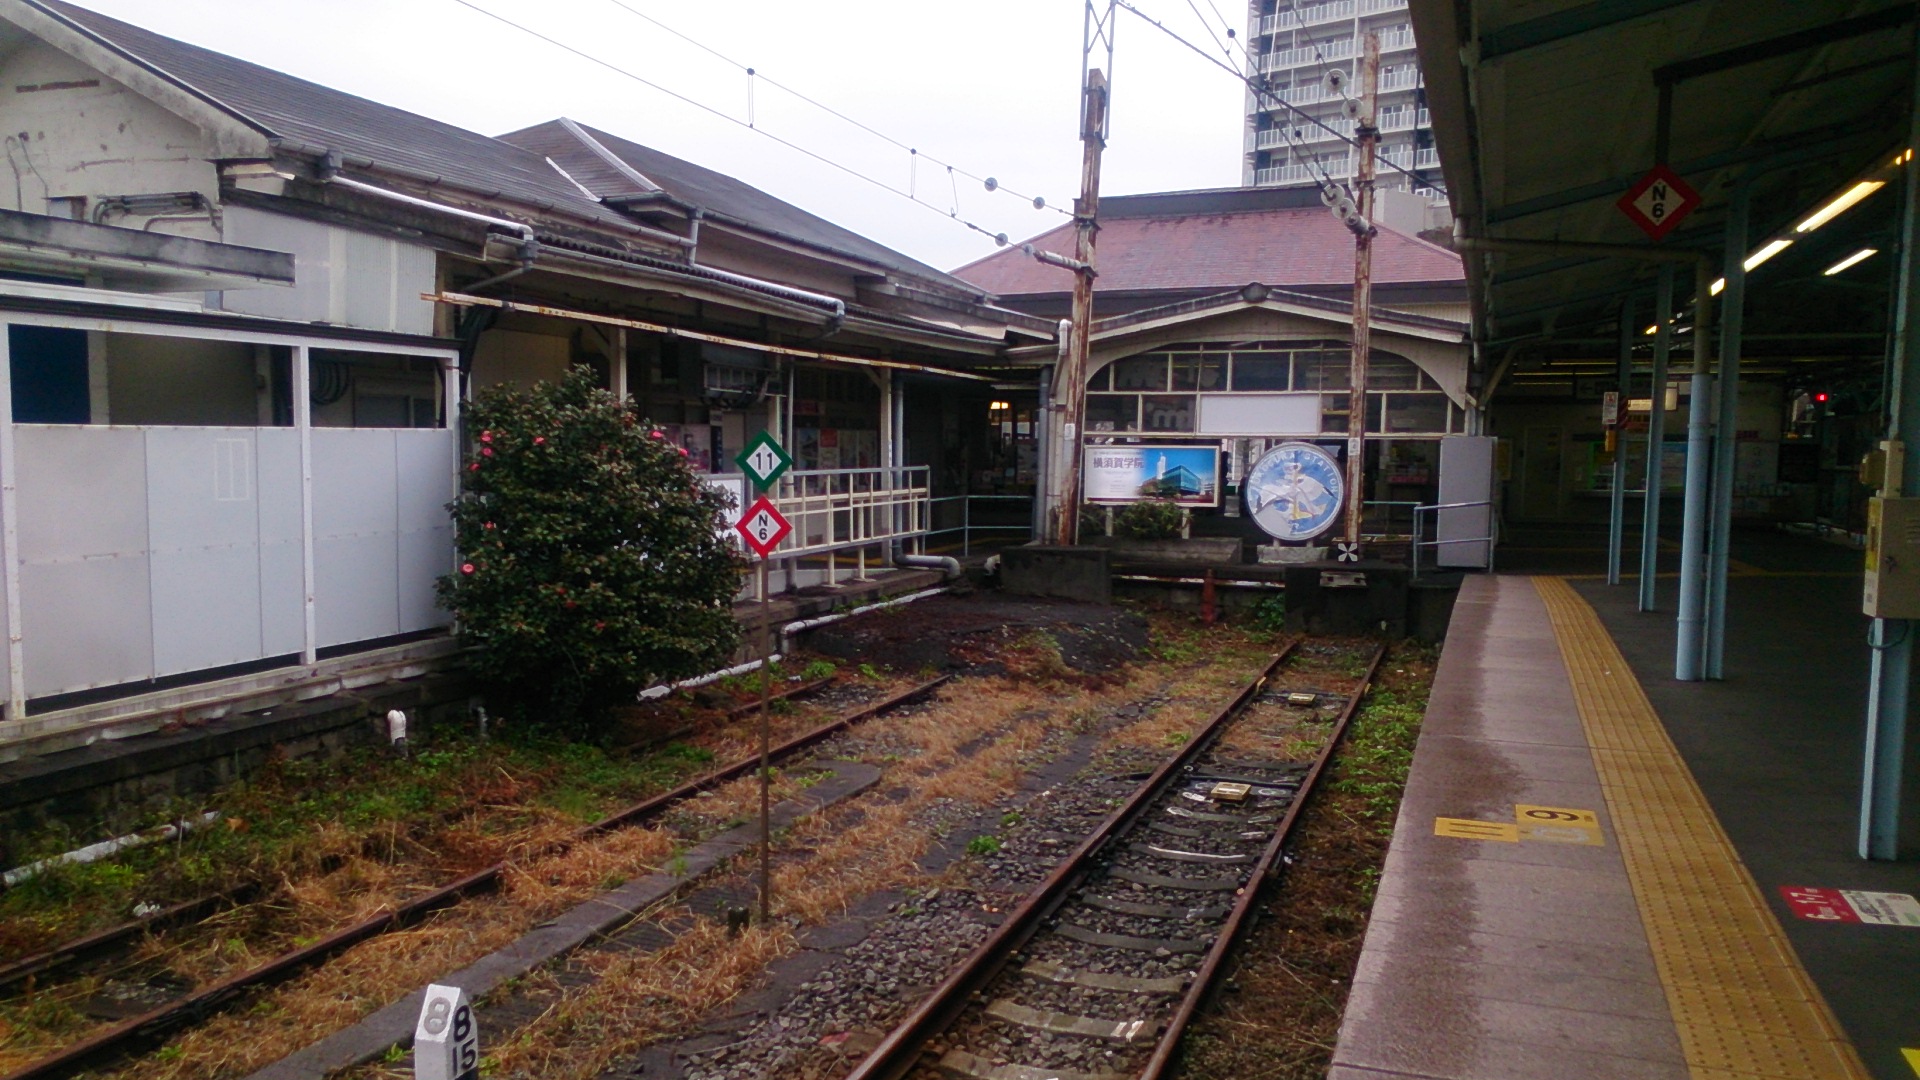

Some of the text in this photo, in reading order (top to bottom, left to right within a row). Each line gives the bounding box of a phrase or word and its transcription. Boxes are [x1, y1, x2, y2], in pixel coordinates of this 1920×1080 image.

[1652, 185, 1666, 201] N
[1652, 203, 1664, 218] 6
[755, 452, 773, 470] 11
[1093, 457, 1145, 469] 横須賀学院
[1304, 452, 1338, 492] STATION
[758, 514, 768, 527] N
[758, 528, 768, 541] 6
[423, 996, 451, 1035] 8
[453, 1004, 471, 1042] 8
[452, 1038, 476, 1076] 15
